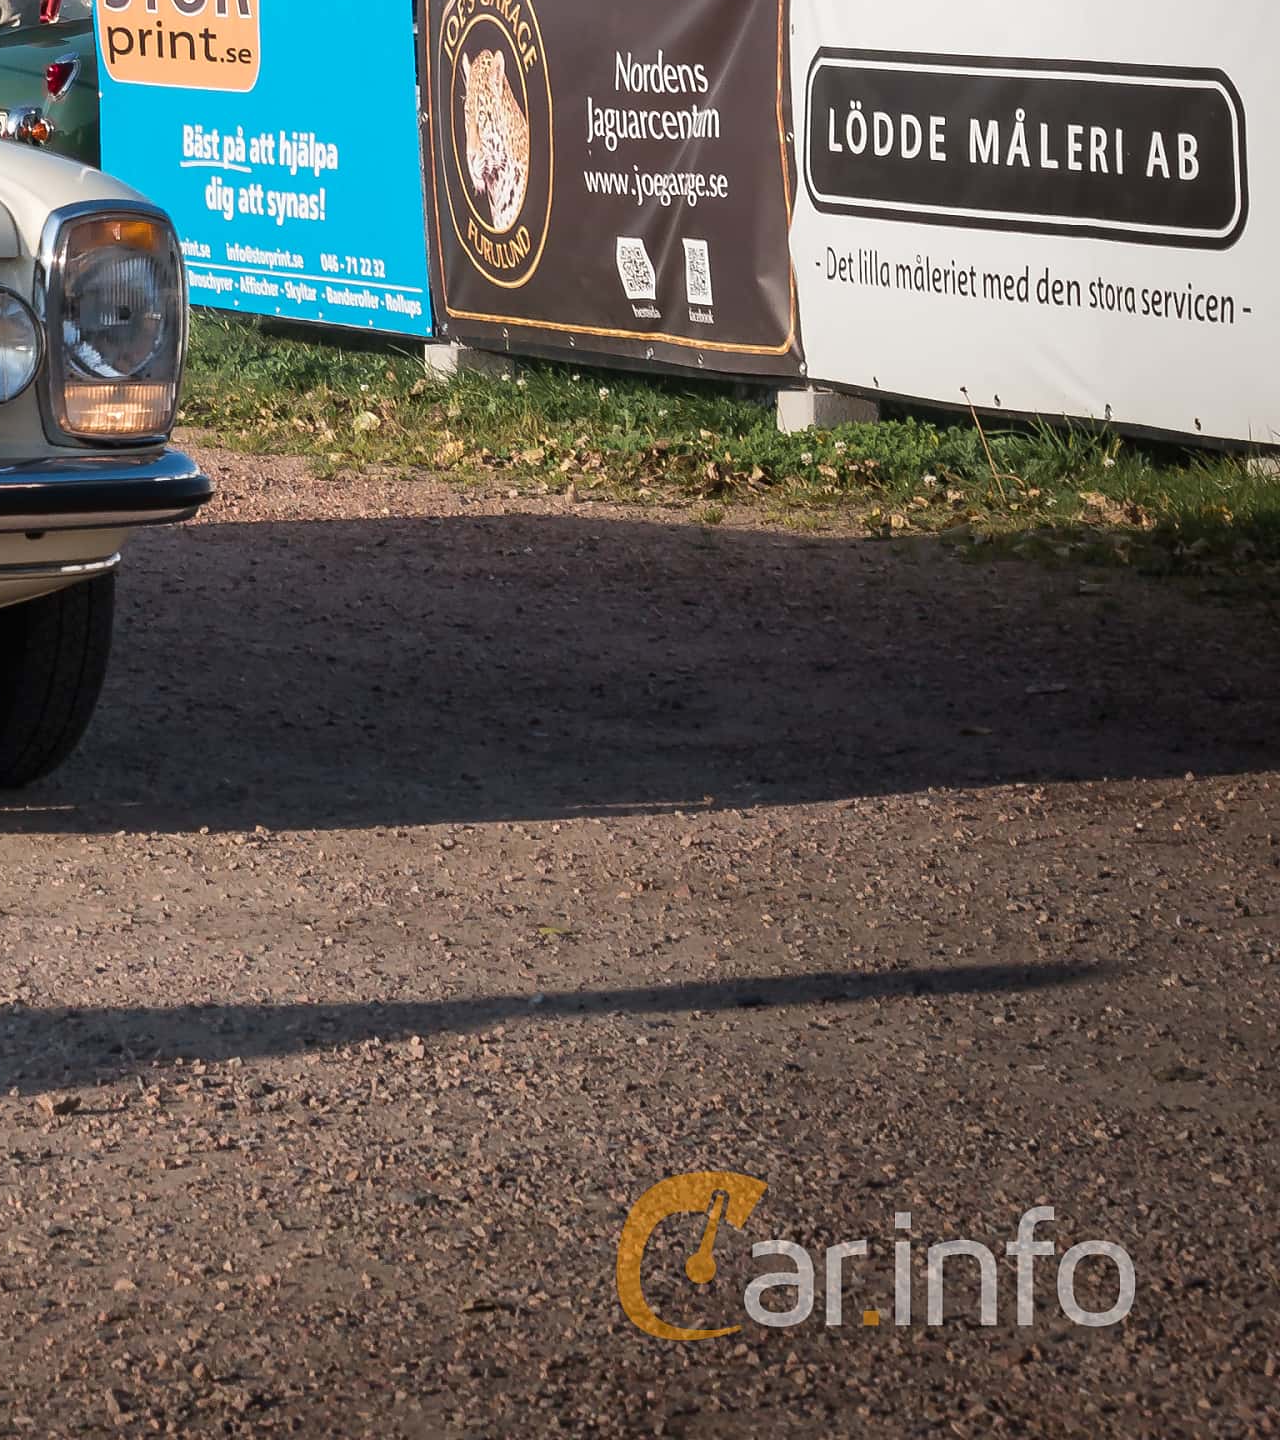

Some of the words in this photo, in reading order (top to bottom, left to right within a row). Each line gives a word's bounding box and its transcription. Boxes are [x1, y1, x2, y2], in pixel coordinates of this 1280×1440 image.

[107, 21, 252, 64] print.se
[615, 49, 709, 93] Nordens
[183, 124, 220, 160] Bäst
[223, 125, 246, 169] på
[250, 133, 275, 165] att
[279, 131, 338, 177] hjälpa
[829, 100, 946, 161] LÖDDE
[969, 108, 1124, 174] MÅLERI
[1146, 131, 1200, 180] AB
[205, 176, 234, 221] dig
[238, 183, 264, 215] att
[267, 187, 326, 226] synas!
[226, 242, 304, 269] info@storprint.se
[320, 253, 339, 273] 046
[345, 256, 358, 275] 71
[359, 257, 372, 277] 22
[373, 258, 386, 278] 32
[467, 218, 531, 269] FURULUND
[284, 281, 317, 304] Skyltar
[385, 293, 422, 319] Rollups
[826, 246, 854, 283] Det
[859, 248, 890, 287] lilla
[896, 254, 977, 297] måleriet
[983, 265, 1030, 303] med
[1036, 267, 1081, 306] den
[1090, 277, 1136, 313] stora
[1141, 282, 1234, 323] servicen
